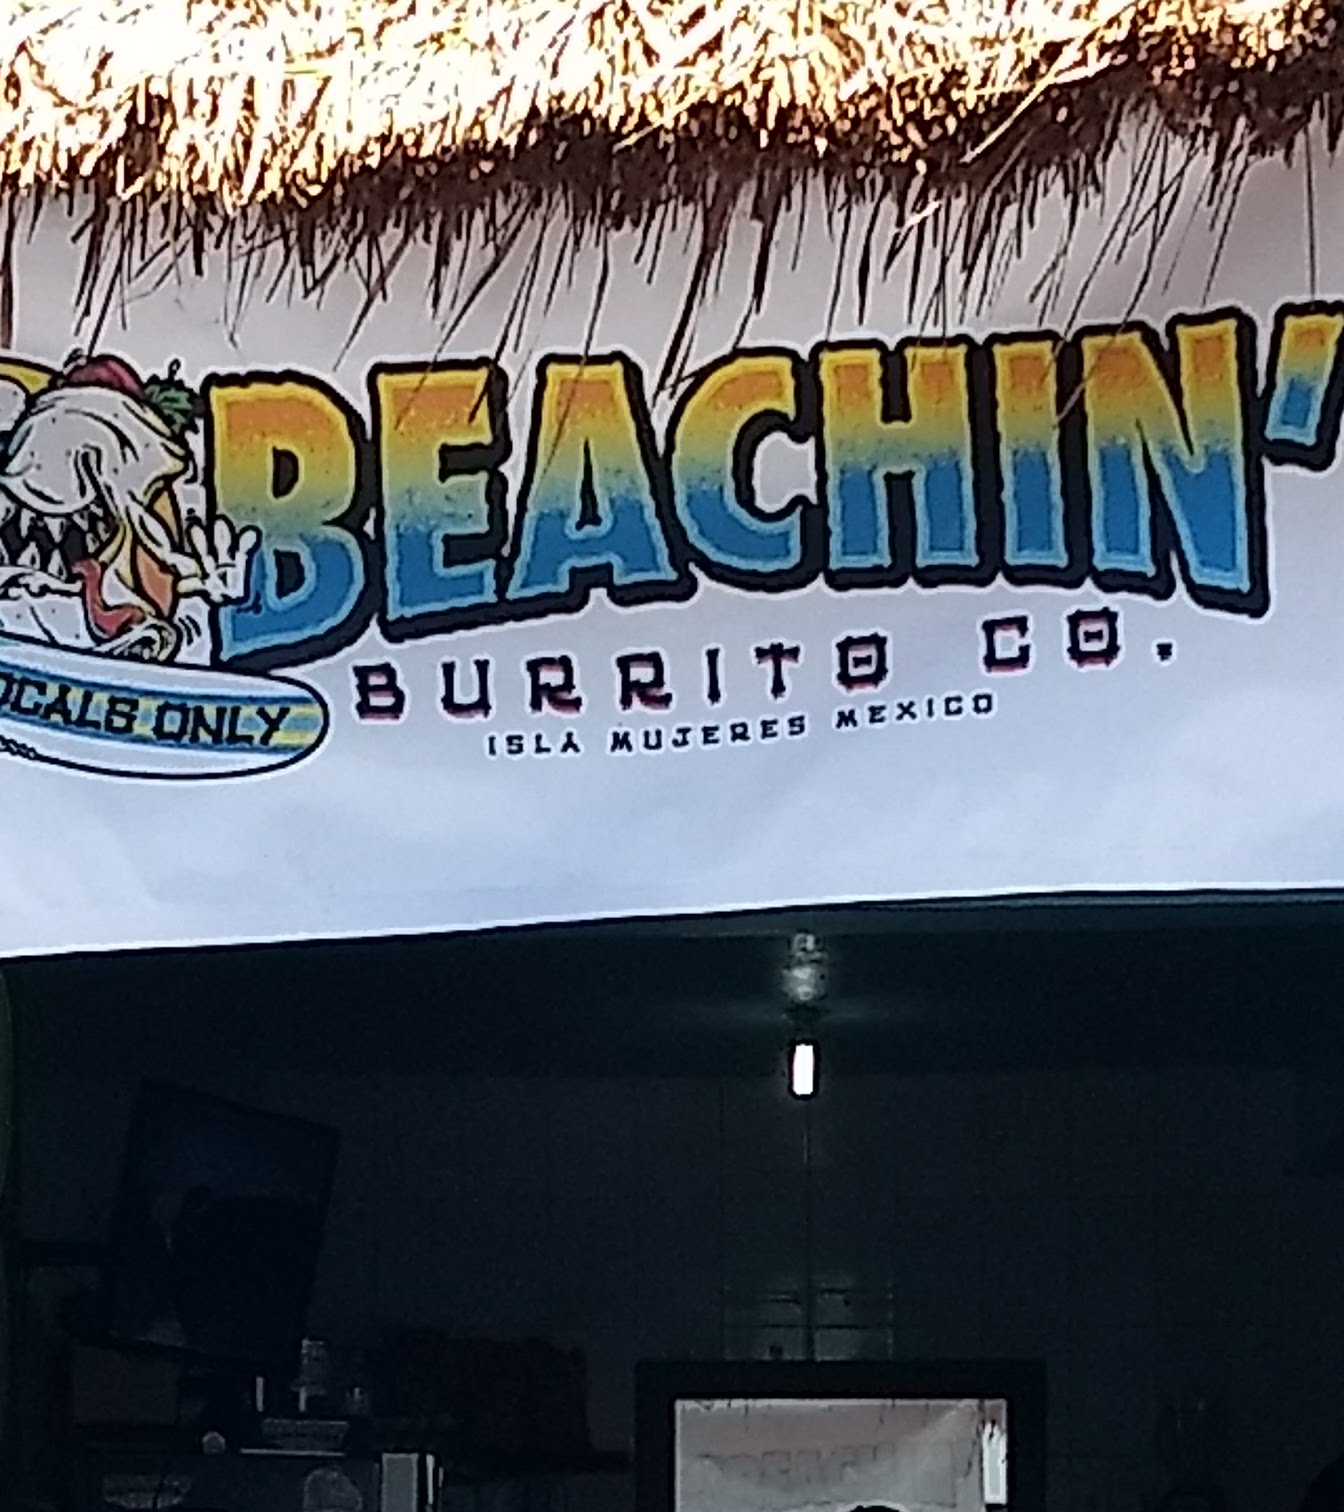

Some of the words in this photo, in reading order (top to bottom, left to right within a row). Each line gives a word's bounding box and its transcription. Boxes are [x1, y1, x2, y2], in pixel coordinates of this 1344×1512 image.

[353, 633, 889, 720] BURRITO
[982, 607, 1173, 672] CO.
[151, 700, 291, 746] ONLY
[487, 731, 581, 756] ISLA
[610, 715, 806, 753] MUJERES
[836, 693, 994, 729] MEXICO
